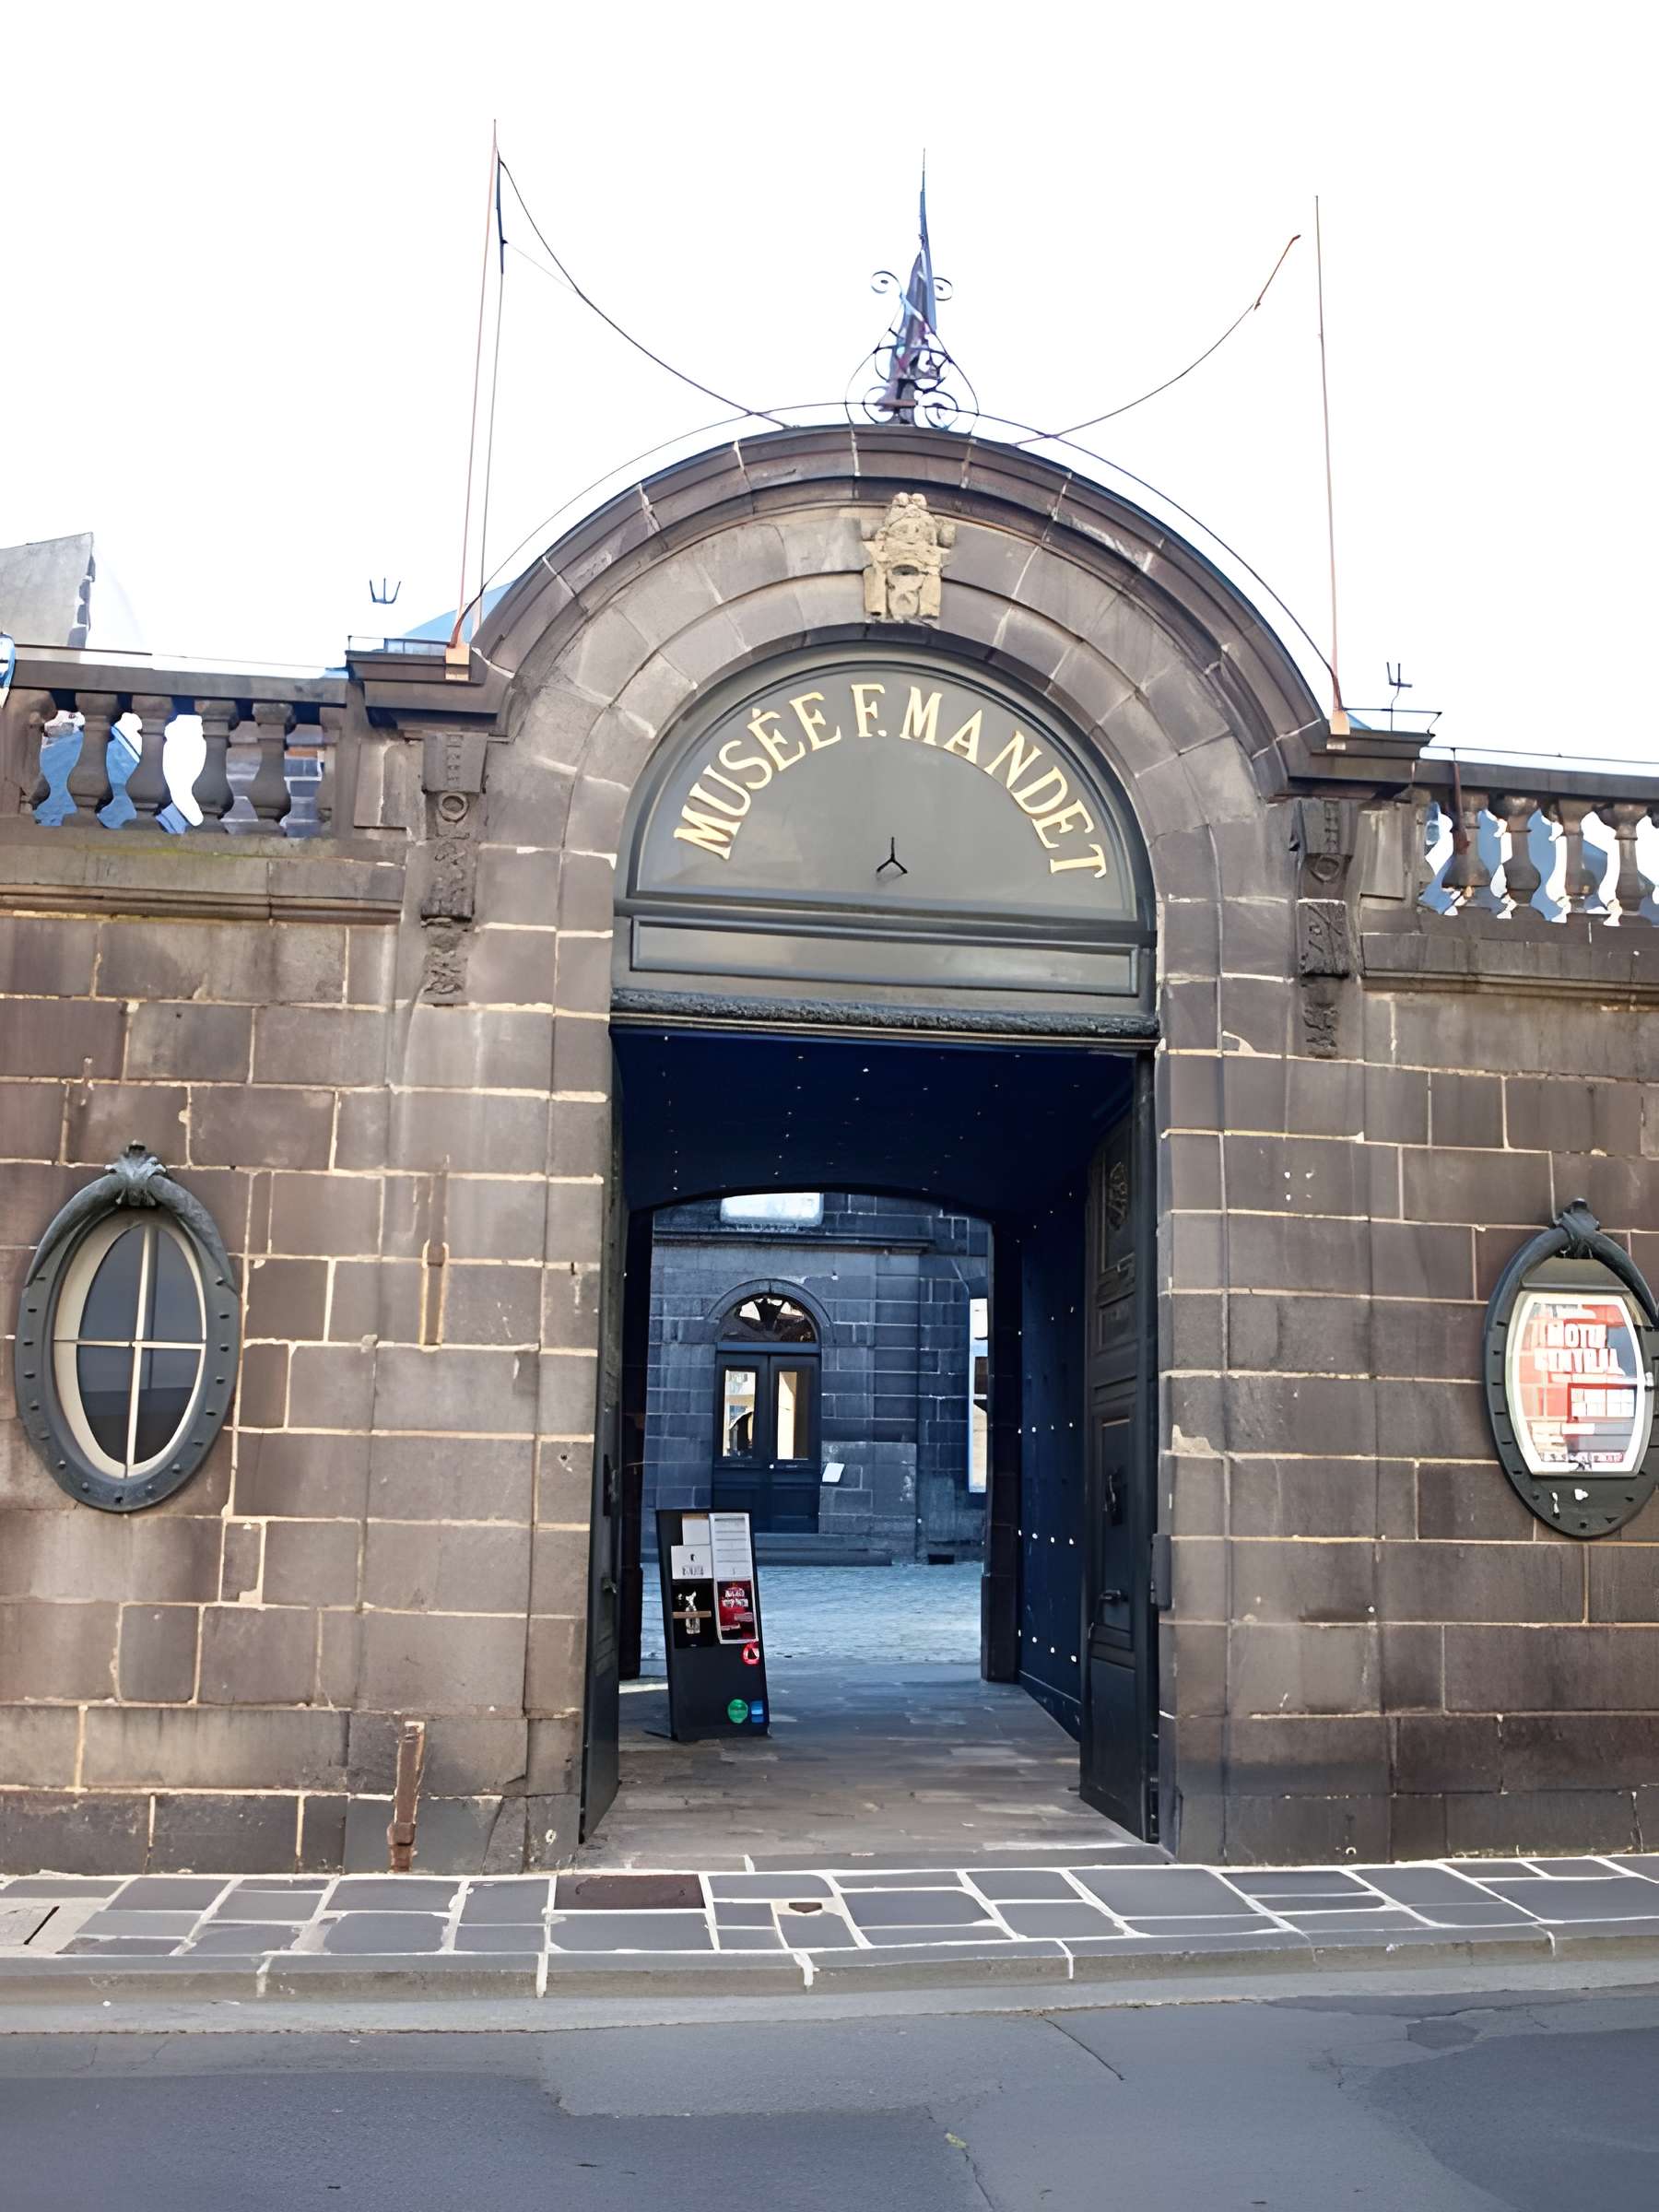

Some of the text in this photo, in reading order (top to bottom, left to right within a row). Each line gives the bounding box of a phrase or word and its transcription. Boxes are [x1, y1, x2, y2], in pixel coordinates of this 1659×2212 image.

[673, 682, 1108, 879] MUSÉE F. MANDET
